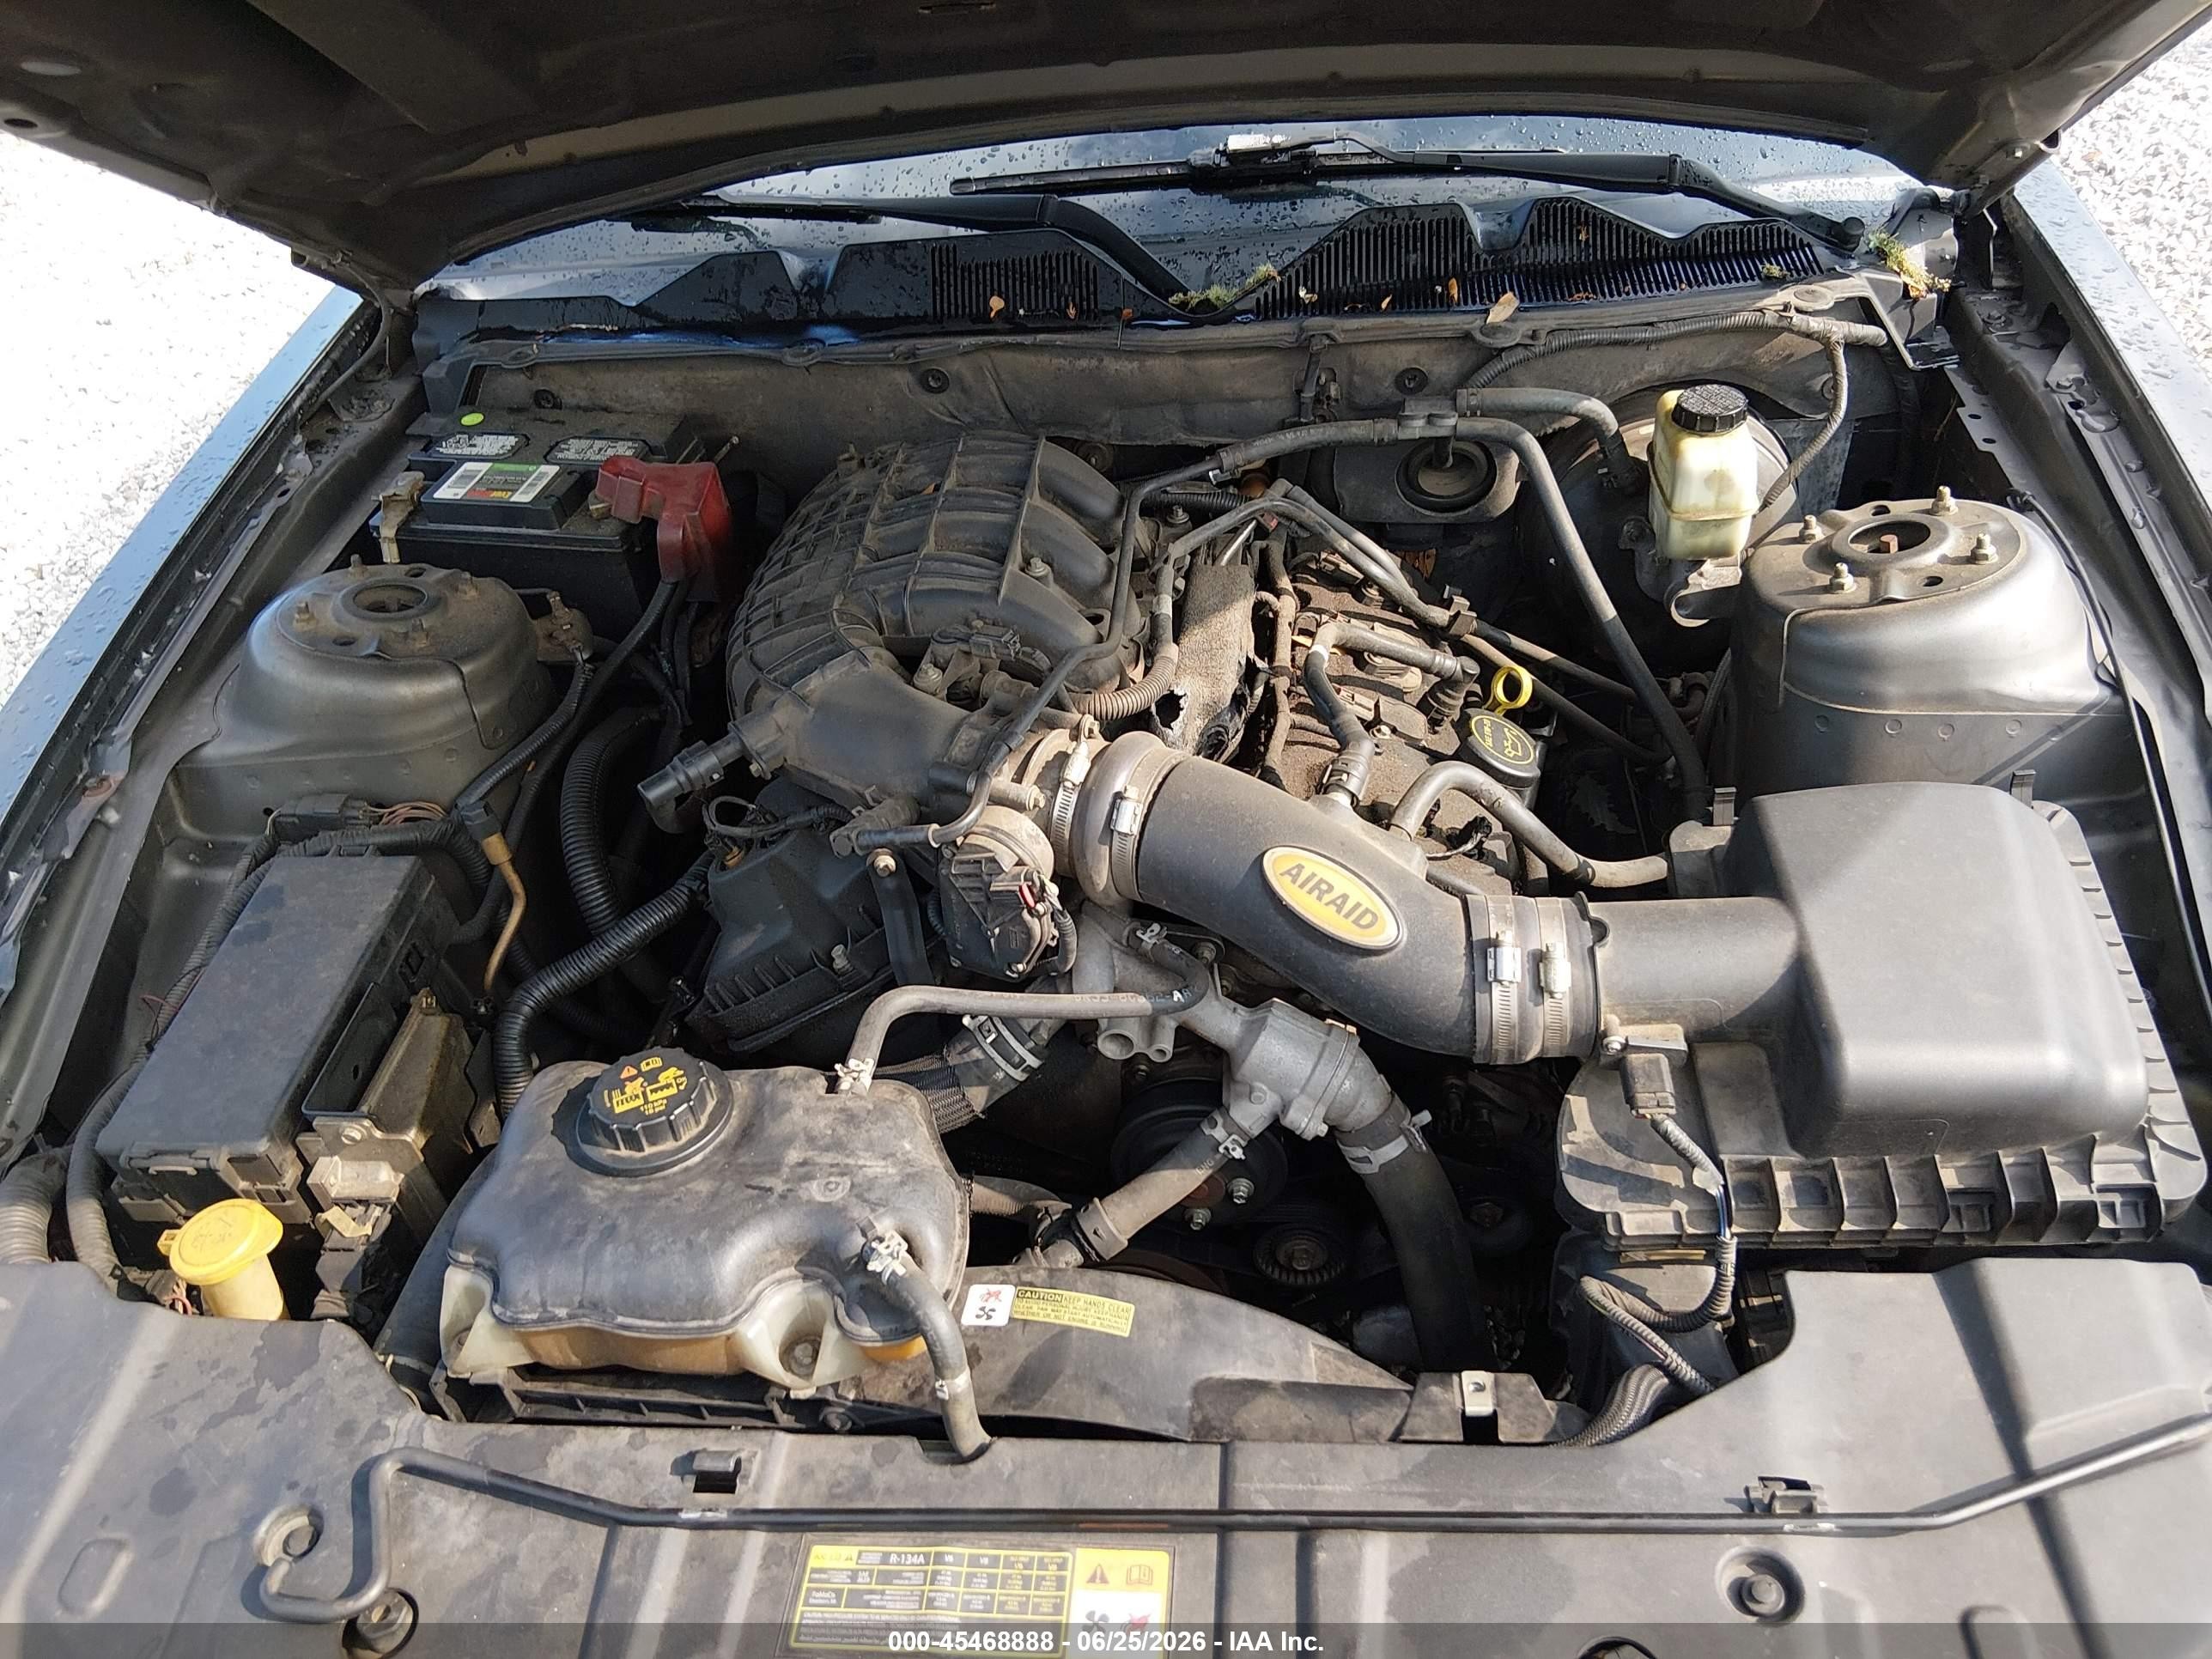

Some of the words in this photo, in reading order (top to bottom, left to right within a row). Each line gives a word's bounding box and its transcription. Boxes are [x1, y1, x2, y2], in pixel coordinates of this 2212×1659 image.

[1279, 863, 1379, 929] AIRAID
[1018, 1290, 1063, 1302] CAUTION
[1064, 1296, 1082, 1304] KEEP
[1084, 1298, 1106, 1308] HANDS
[1108, 1304, 1131, 1313] CLEAR
[889, 1553, 926, 1565] R-134A
